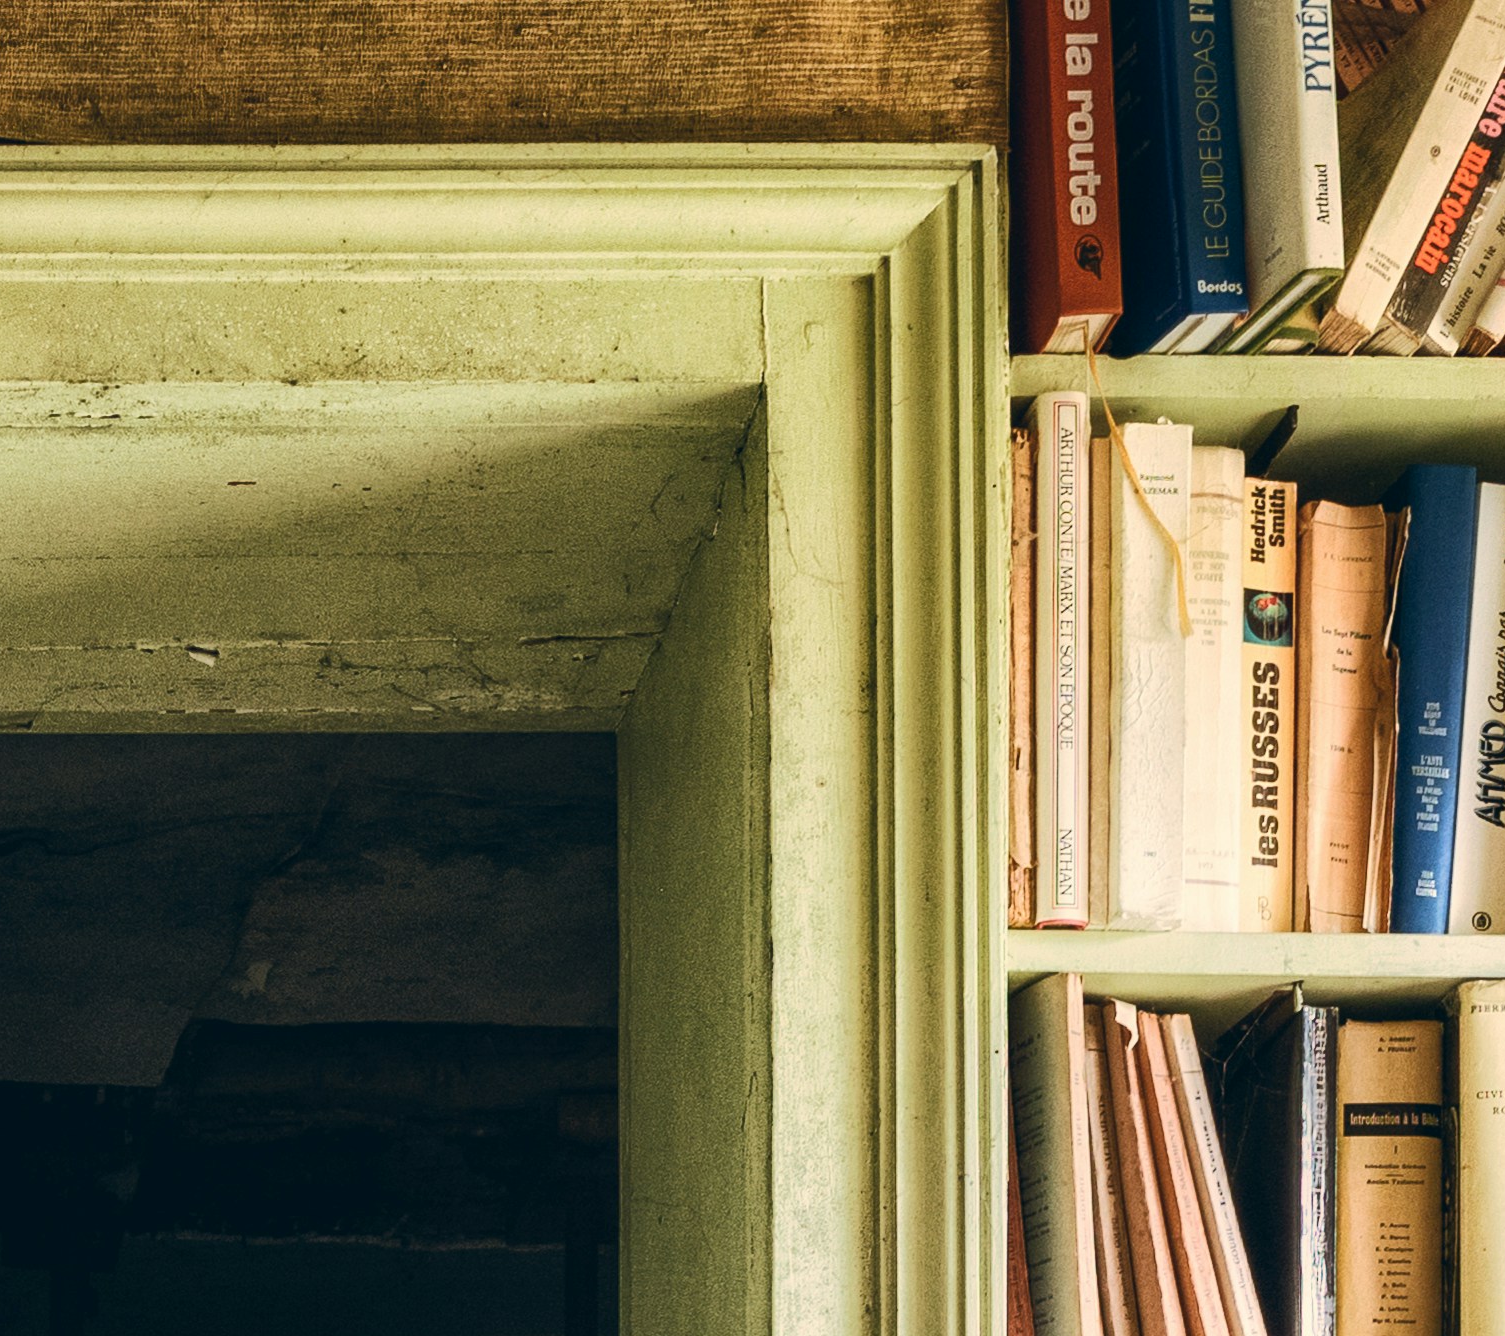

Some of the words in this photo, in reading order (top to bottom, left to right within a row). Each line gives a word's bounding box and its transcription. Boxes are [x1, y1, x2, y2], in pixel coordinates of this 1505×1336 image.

[1065, 32, 1095, 75] la
[1192, 29, 1222, 140] BORDAS
[1068, 89, 1099, 225] route
[1200, 144, 1227, 228] GUIDE
[1314, 163, 1330, 224] Arthaud
[1412, 140, 1494, 273] marocain
[1204, 235, 1229, 259] LE
[1196, 279, 1243, 296] Bordas
[1251, 486, 1268, 564] Hedrick
[1268, 489, 1285, 547] Smith
[1252, 662, 1280, 809] RUSSES
[1251, 815, 1279, 867] les
